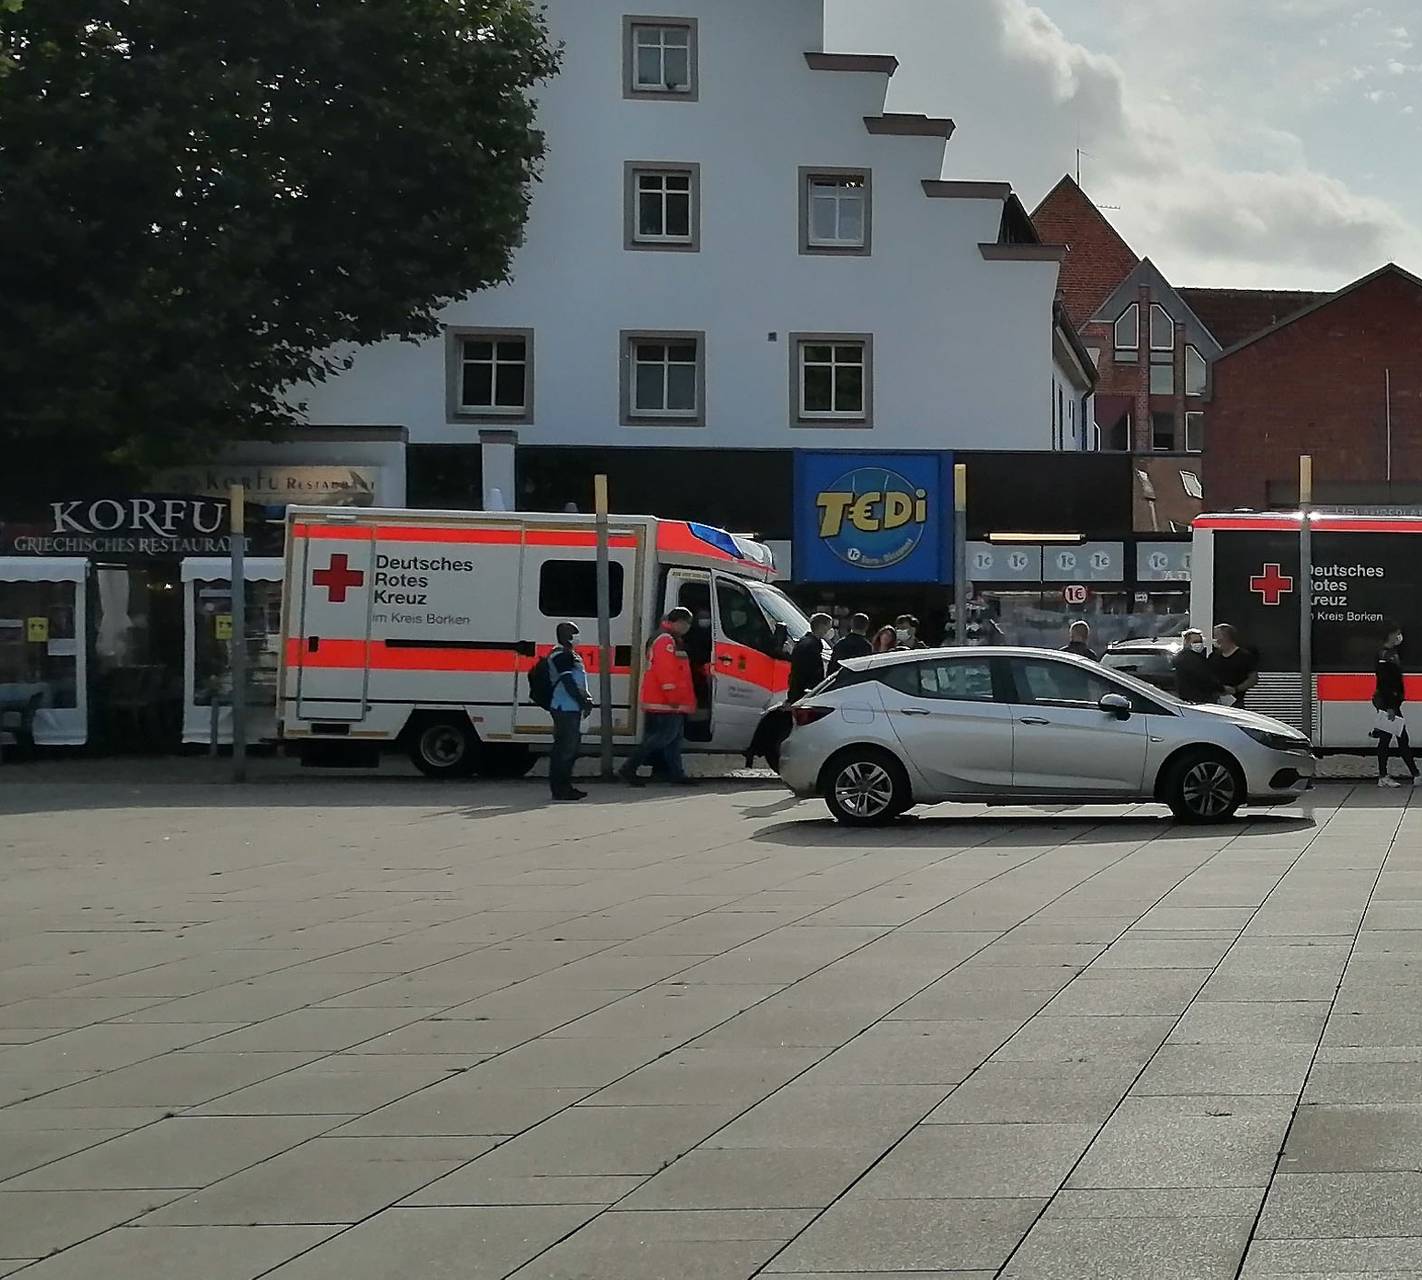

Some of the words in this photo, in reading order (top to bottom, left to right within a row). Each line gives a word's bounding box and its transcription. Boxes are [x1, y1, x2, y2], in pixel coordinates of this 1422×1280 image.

[50, 499, 227, 538] KORFU
[14, 536, 135, 555] GRIECHISCHES
[376, 555, 473, 571] Deutsches
[375, 572, 428, 588] Rotes
[1311, 579, 1348, 591] otes
[374, 590, 427, 605] Kreuz
[391, 612, 422, 624] Kreis
[426, 613, 470, 625] Borken
[1317, 611, 1344, 621] Kreis
[1347, 611, 1383, 622] Borken
